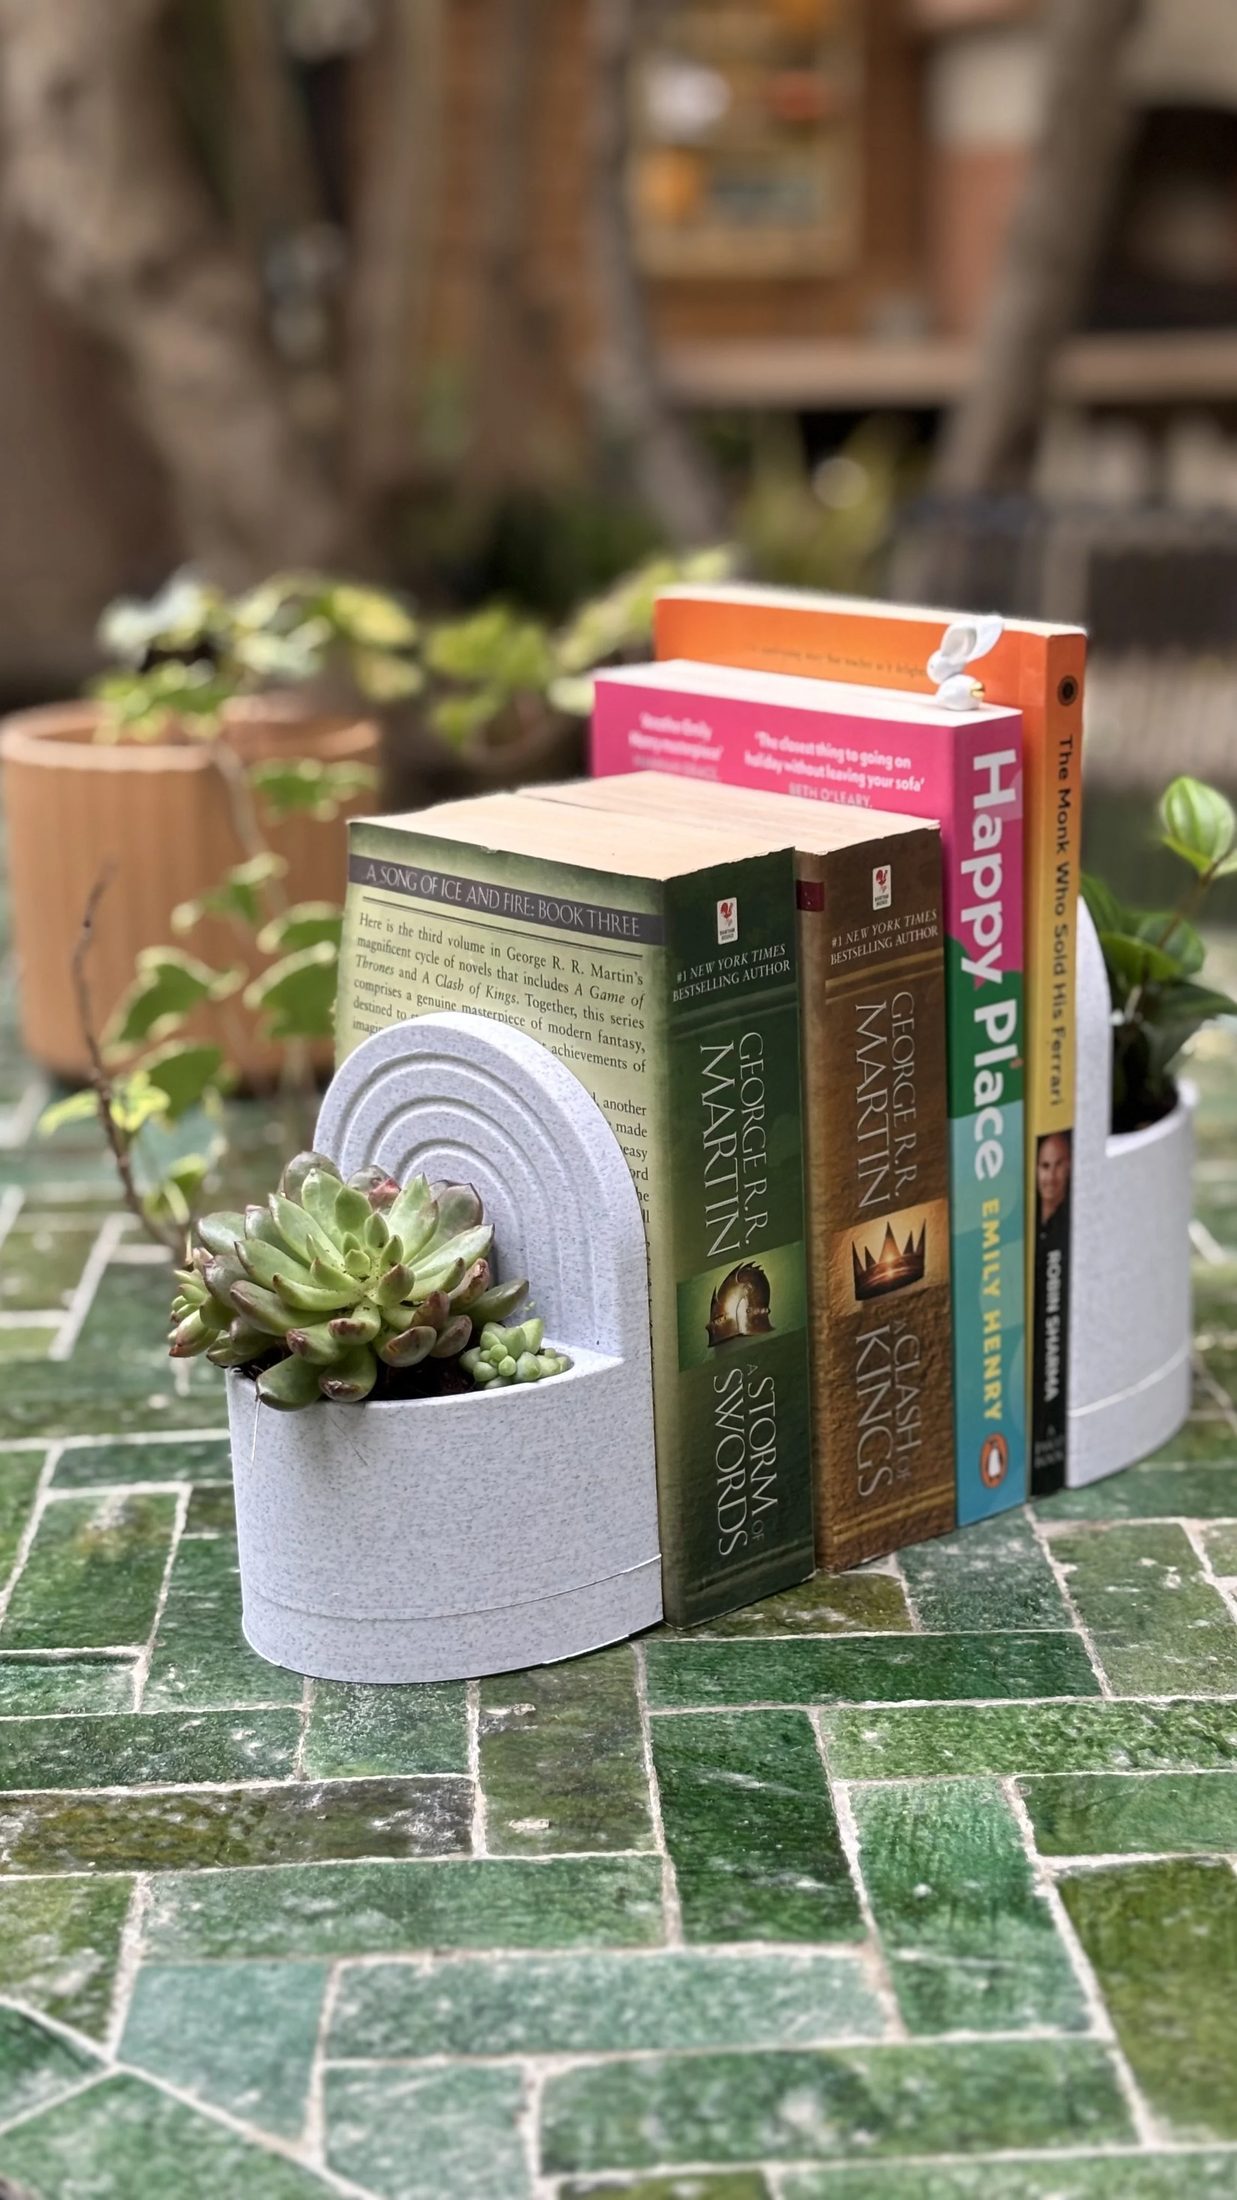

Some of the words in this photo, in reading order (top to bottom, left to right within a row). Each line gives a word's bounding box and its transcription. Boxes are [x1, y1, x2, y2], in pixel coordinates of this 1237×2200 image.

[744, 750, 784, 774] holiday
[784, 759, 824, 779] without
[825, 764, 866, 788] leaving
[868, 774, 894, 791] your
[779, 738, 814, 755] closest
[816, 741, 844, 764] thing
[846, 747, 859, 762] to
[860, 750, 892, 770] going
[895, 756, 911, 770] on
[1058, 734, 1073, 780] The
[1056, 788, 1072, 854] Monk
[366, 864, 376, 882] A
[380, 866, 417, 891] SONG
[420, 874, 438, 894] OF
[441, 878, 462, 900] ICE
[465, 885, 500, 909] AND
[504, 892, 534, 917] FIRE:
[538, 899, 584, 928] BOOK
[587, 909, 641, 937] THREE
[961, 749, 1016, 984] Happy
[1054, 860, 1070, 916] Who
[360, 912, 382, 930] Here
[386, 918, 394, 933] is
[399, 922, 414, 938] the
[418, 928, 443, 945] third
[448, 935, 485, 954] volume
[491, 942, 501, 957] in
[506, 946, 546, 970] George
[552, 956, 565, 970] R.
[571, 960, 584, 974] R.
[590, 963, 644, 986] Martin's
[830, 937, 893, 966] BESTSELLING
[895, 925, 939, 946] AUTHOR
[832, 936, 842, 948] #1
[845, 928, 870, 945] NEW
[872, 919, 902, 936] YORK
[904, 908, 937, 928] TIMES
[1054, 923, 1069, 976] Sold
[356, 954, 394, 976] Thrones
[399, 968, 416, 981] and
[422, 972, 430, 984] A
[436, 974, 464, 992] Clash
[470, 982, 482, 998] of
[486, 985, 520, 1006] Kings.
[525, 994, 578, 1019] Together,
[584, 1005, 604, 1022] this
[610, 1014, 645, 1030] series
[357, 936, 411, 958] magnificent
[415, 949, 440, 966] cycle
[444, 954, 456, 968] of
[459, 961, 492, 978] novels
[497, 966, 518, 982] that
[524, 971, 569, 993] includes
[574, 983, 582, 996] A
[590, 986, 625, 1004] Game
[631, 990, 646, 1010] of
[672, 973, 740, 1002] BESTSELLING
[742, 960, 790, 982] AUTHOR
[677, 968, 687, 984] #1
[690, 960, 716, 979] NEW
[718, 952, 749, 970] YORK
[752, 944, 786, 962] TIMES
[354, 997, 392, 1018] destined
[397, 1008, 406, 1021] to
[354, 979, 402, 999] comprises
[406, 992, 412, 1001] a
[416, 994, 456, 1011] genuine
[462, 1003, 525, 1026] masterpiece
[531, 1016, 543, 1031] of
[548, 1022, 592, 1041] modern
[598, 1030, 646, 1054] fantasy,
[1052, 982, 1067, 1020] His
[551, 1043, 628, 1070] achievements
[633, 1059, 646, 1072] of
[892, 992, 917, 1128] GEORGE
[974, 999, 1018, 1181] Place
[1050, 1026, 1066, 1106] Ferrari
[603, 1099, 647, 1116] another
[616, 1122, 648, 1138] made
[738, 1032, 768, 1174] GEORGE
[856, 1000, 891, 1208] MARTIN
[700, 1040, 741, 1258] MARTIN
[982, 1198, 1000, 1298] EMILY
[1046, 1249, 1062, 1312] ROBIN
[746, 1363, 758, 1376] A
[983, 1310, 1002, 1420] HENRY
[1044, 1314, 1062, 1402] SHARMA
[856, 1325, 894, 1497] KINGS
[893, 1334, 922, 1452] CLASH
[713, 1368, 748, 1556] SWORDS
[748, 1376, 778, 1517] STORM
[896, 1456, 910, 1480] OF
[751, 1520, 764, 1542] OF
